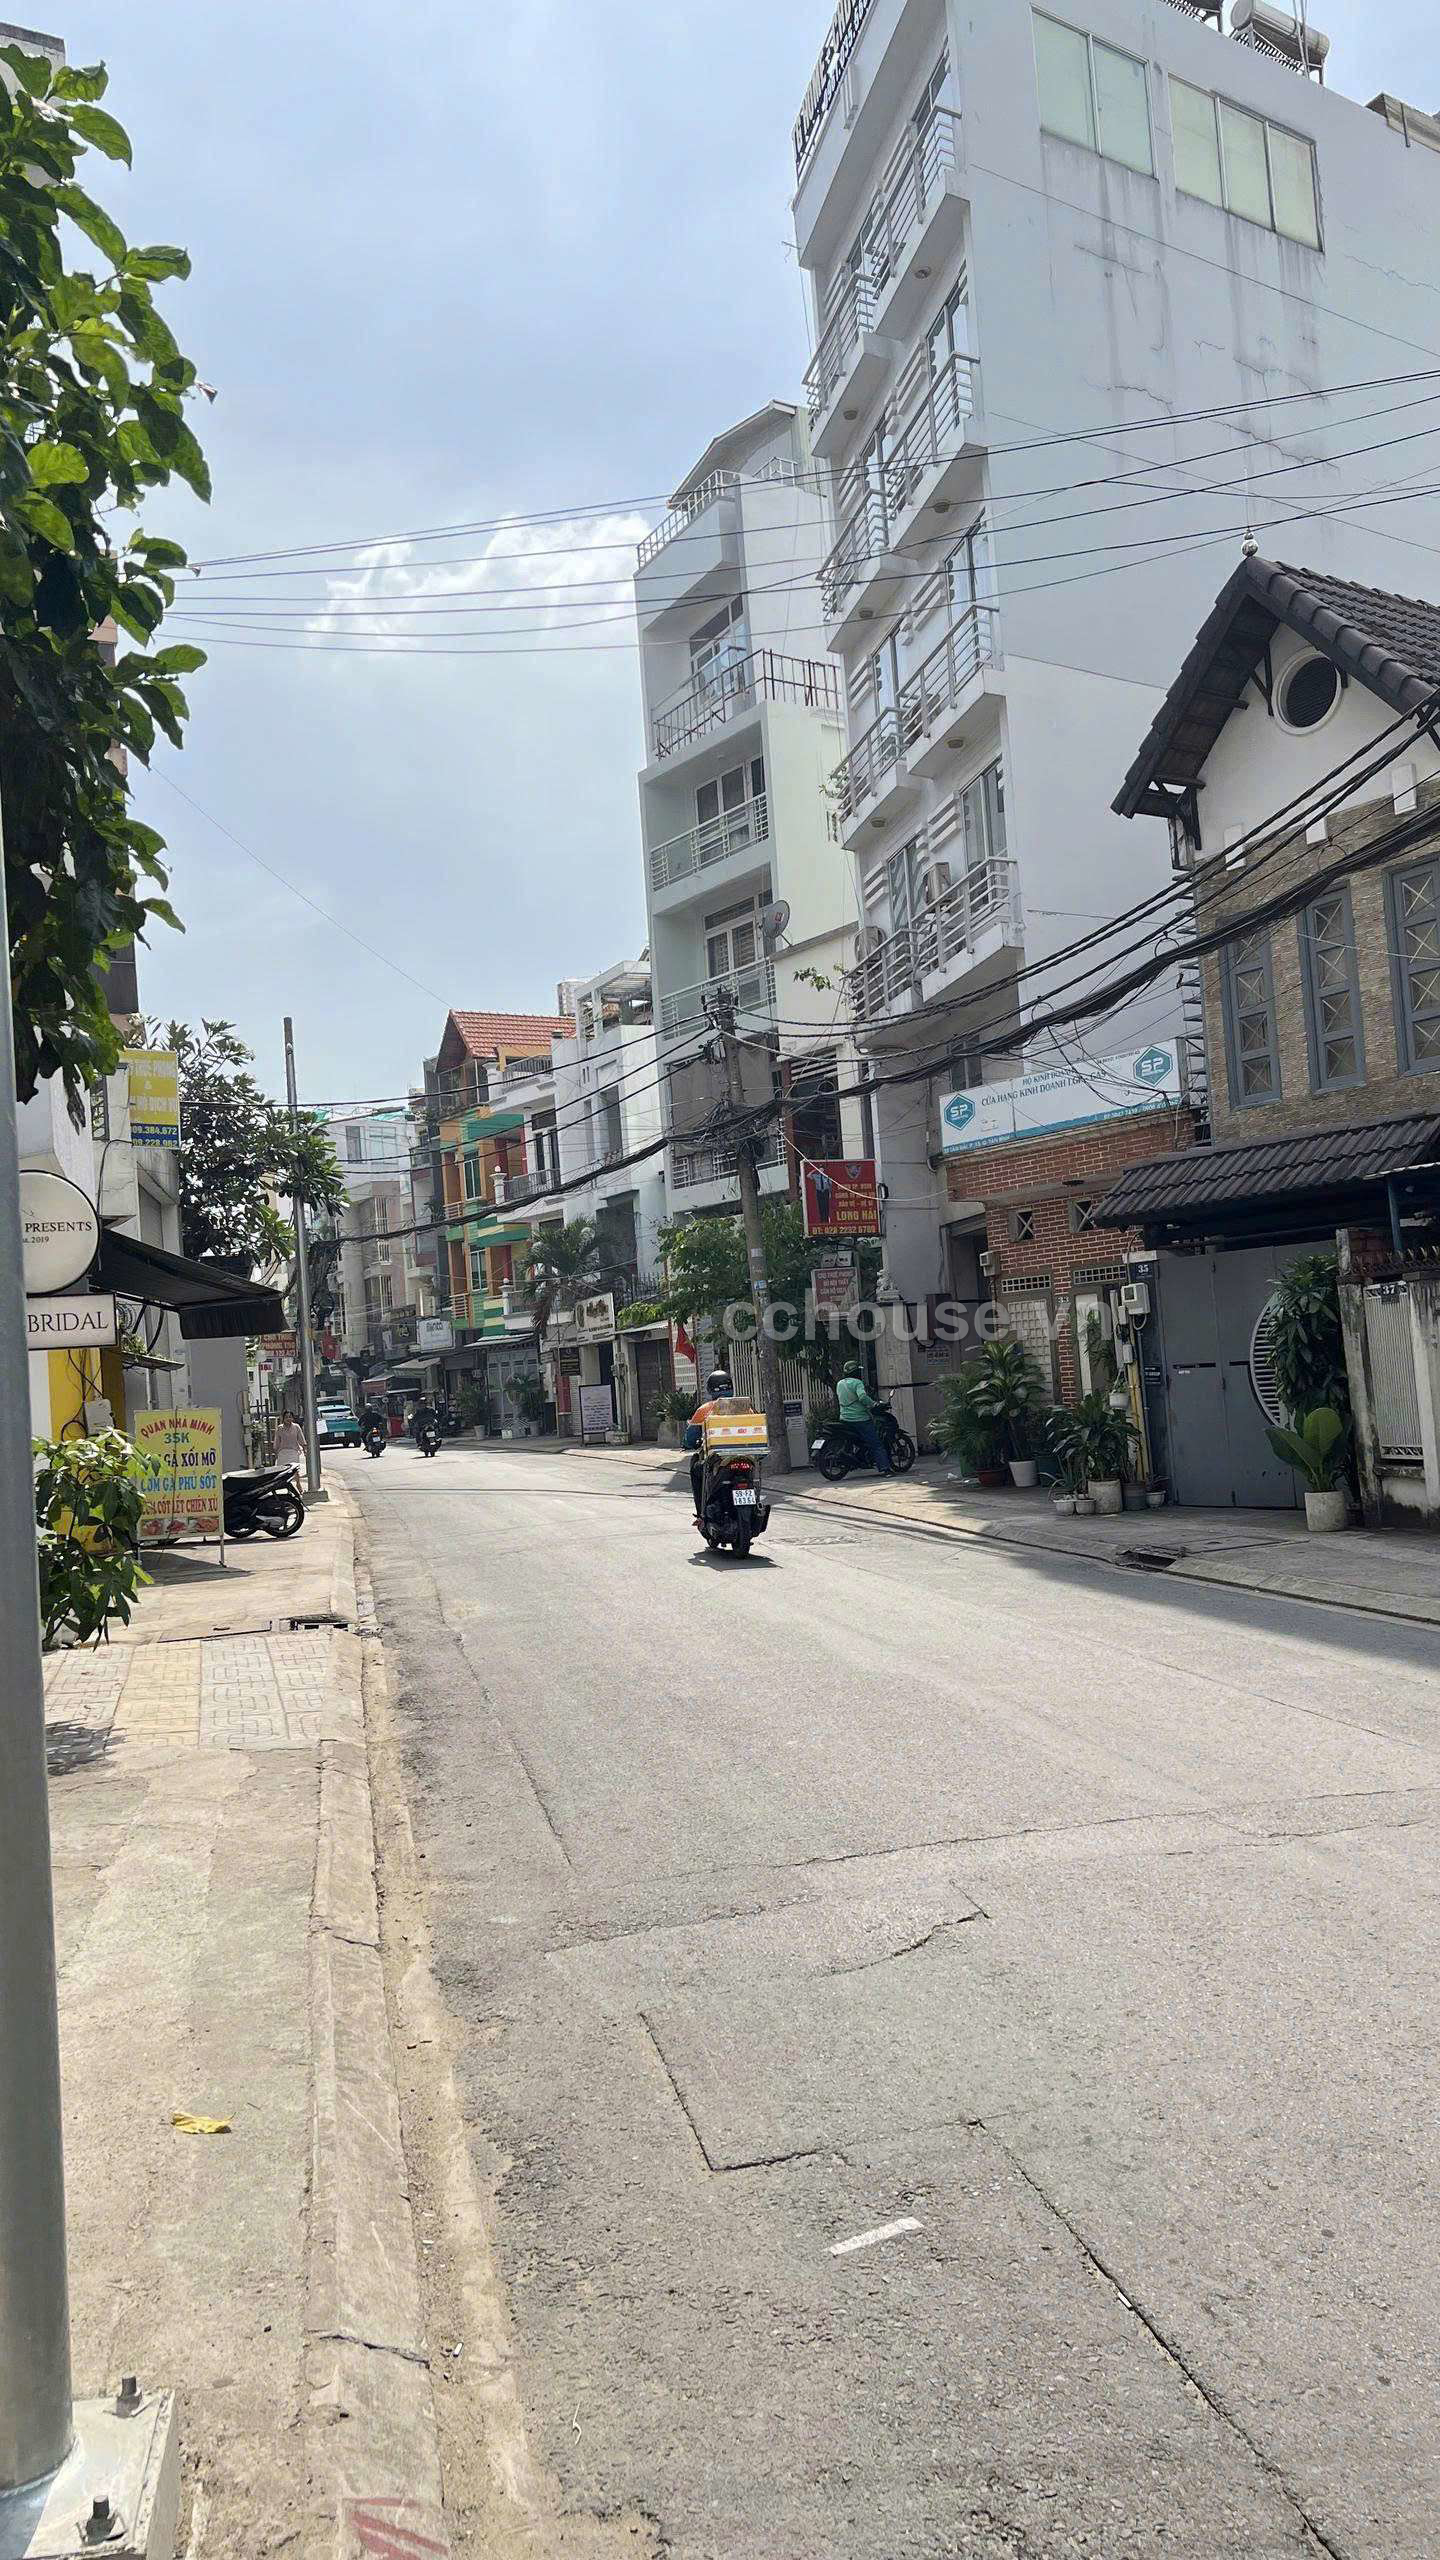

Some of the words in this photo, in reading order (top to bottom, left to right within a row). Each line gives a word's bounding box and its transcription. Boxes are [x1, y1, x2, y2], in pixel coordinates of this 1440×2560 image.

[1020, 1086, 1039, 1097] KINH
[950, 1103, 968, 1118] SP
[836, 1210, 859, 1221] LONG
[24, 1221, 92, 1233] PRESENTS
[31, 1236, 50, 1244] 2019
[1137, 1264, 1149, 1273] 35
[1382, 1284, 1396, 1295] 37
[27, 1310, 109, 1333] BRIDAL
[164, 1432, 190, 1444] 35K
